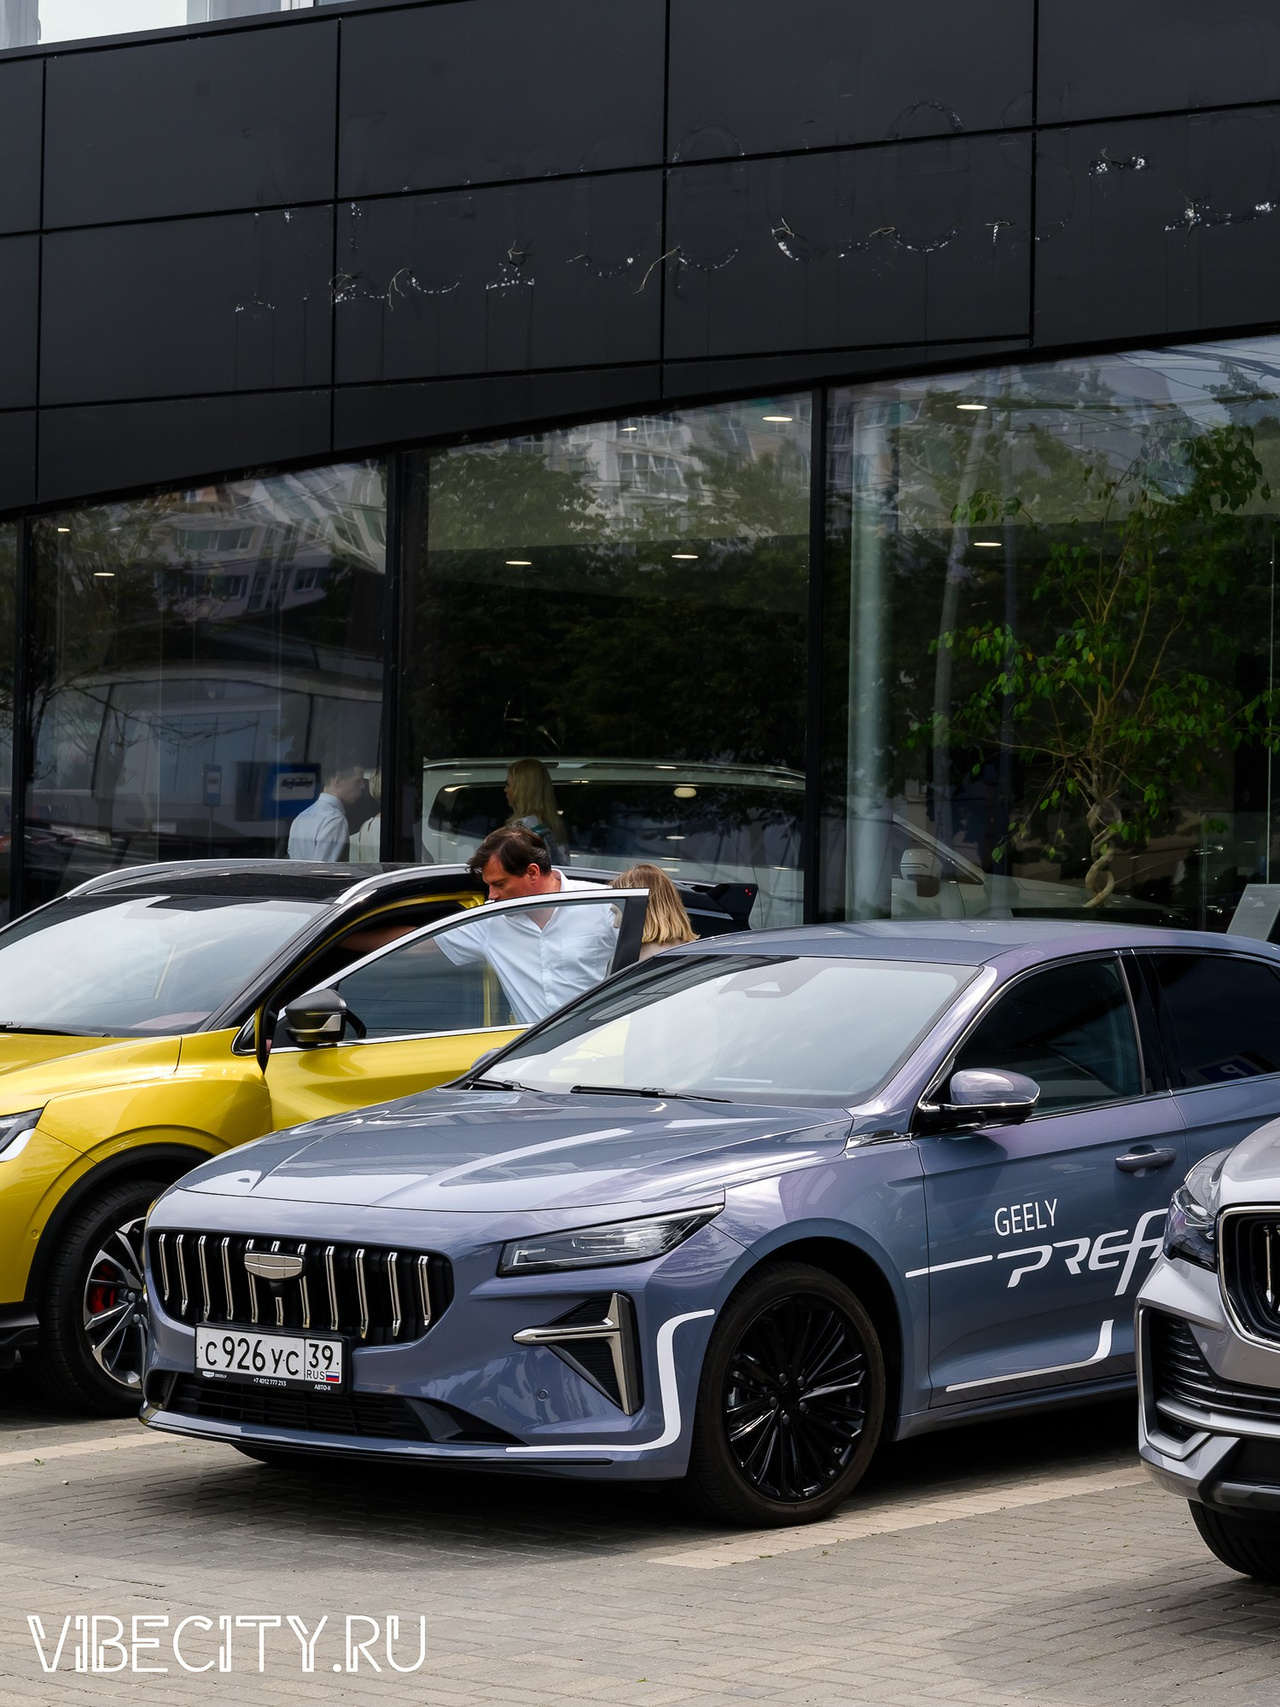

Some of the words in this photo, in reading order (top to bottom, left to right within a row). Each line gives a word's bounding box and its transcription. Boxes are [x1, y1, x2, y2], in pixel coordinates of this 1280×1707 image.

[995, 1199, 1058, 1236] GEELY
[205, 1335, 299, 1376] С926УС
[308, 1343, 334, 1370] 39
[306, 1369, 325, 1381] RUS
